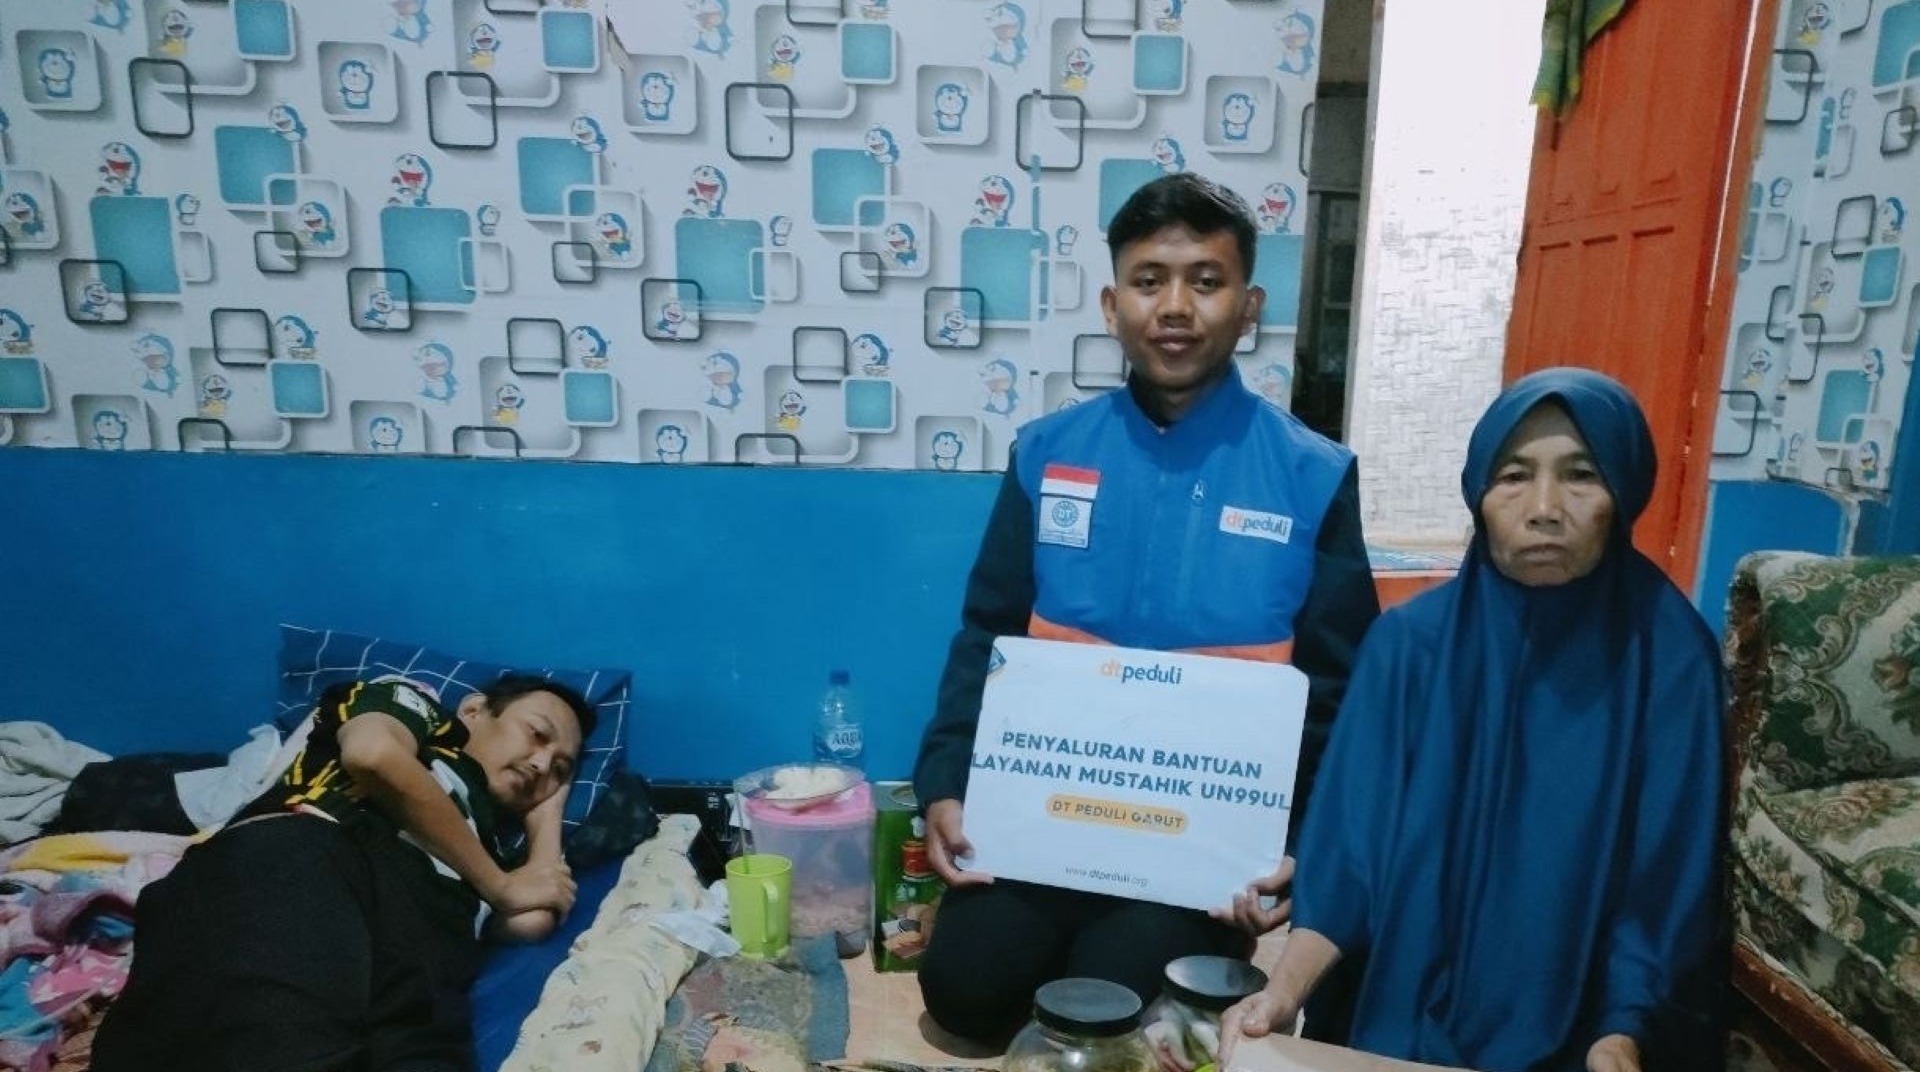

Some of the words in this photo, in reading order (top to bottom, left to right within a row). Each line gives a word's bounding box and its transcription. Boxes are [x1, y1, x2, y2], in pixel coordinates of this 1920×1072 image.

[1225, 511, 1288, 536] dtpeduli
[1100, 659, 1182, 684] dtpeduli
[1002, 731, 1145, 763] PENYALURAN
[1152, 749, 1262, 779] BANTUAN
[972, 752, 1072, 781] LAYANAN
[1078, 765, 1193, 796] MUSTAHIK
[1200, 782, 1291, 811] UN99UL
[1052, 800, 1072, 812] DT
[1075, 803, 1127, 820] PEDULI
[1131, 811, 1184, 828] GARUT
[1065, 866, 1148, 887] www.dtpeduli.org
